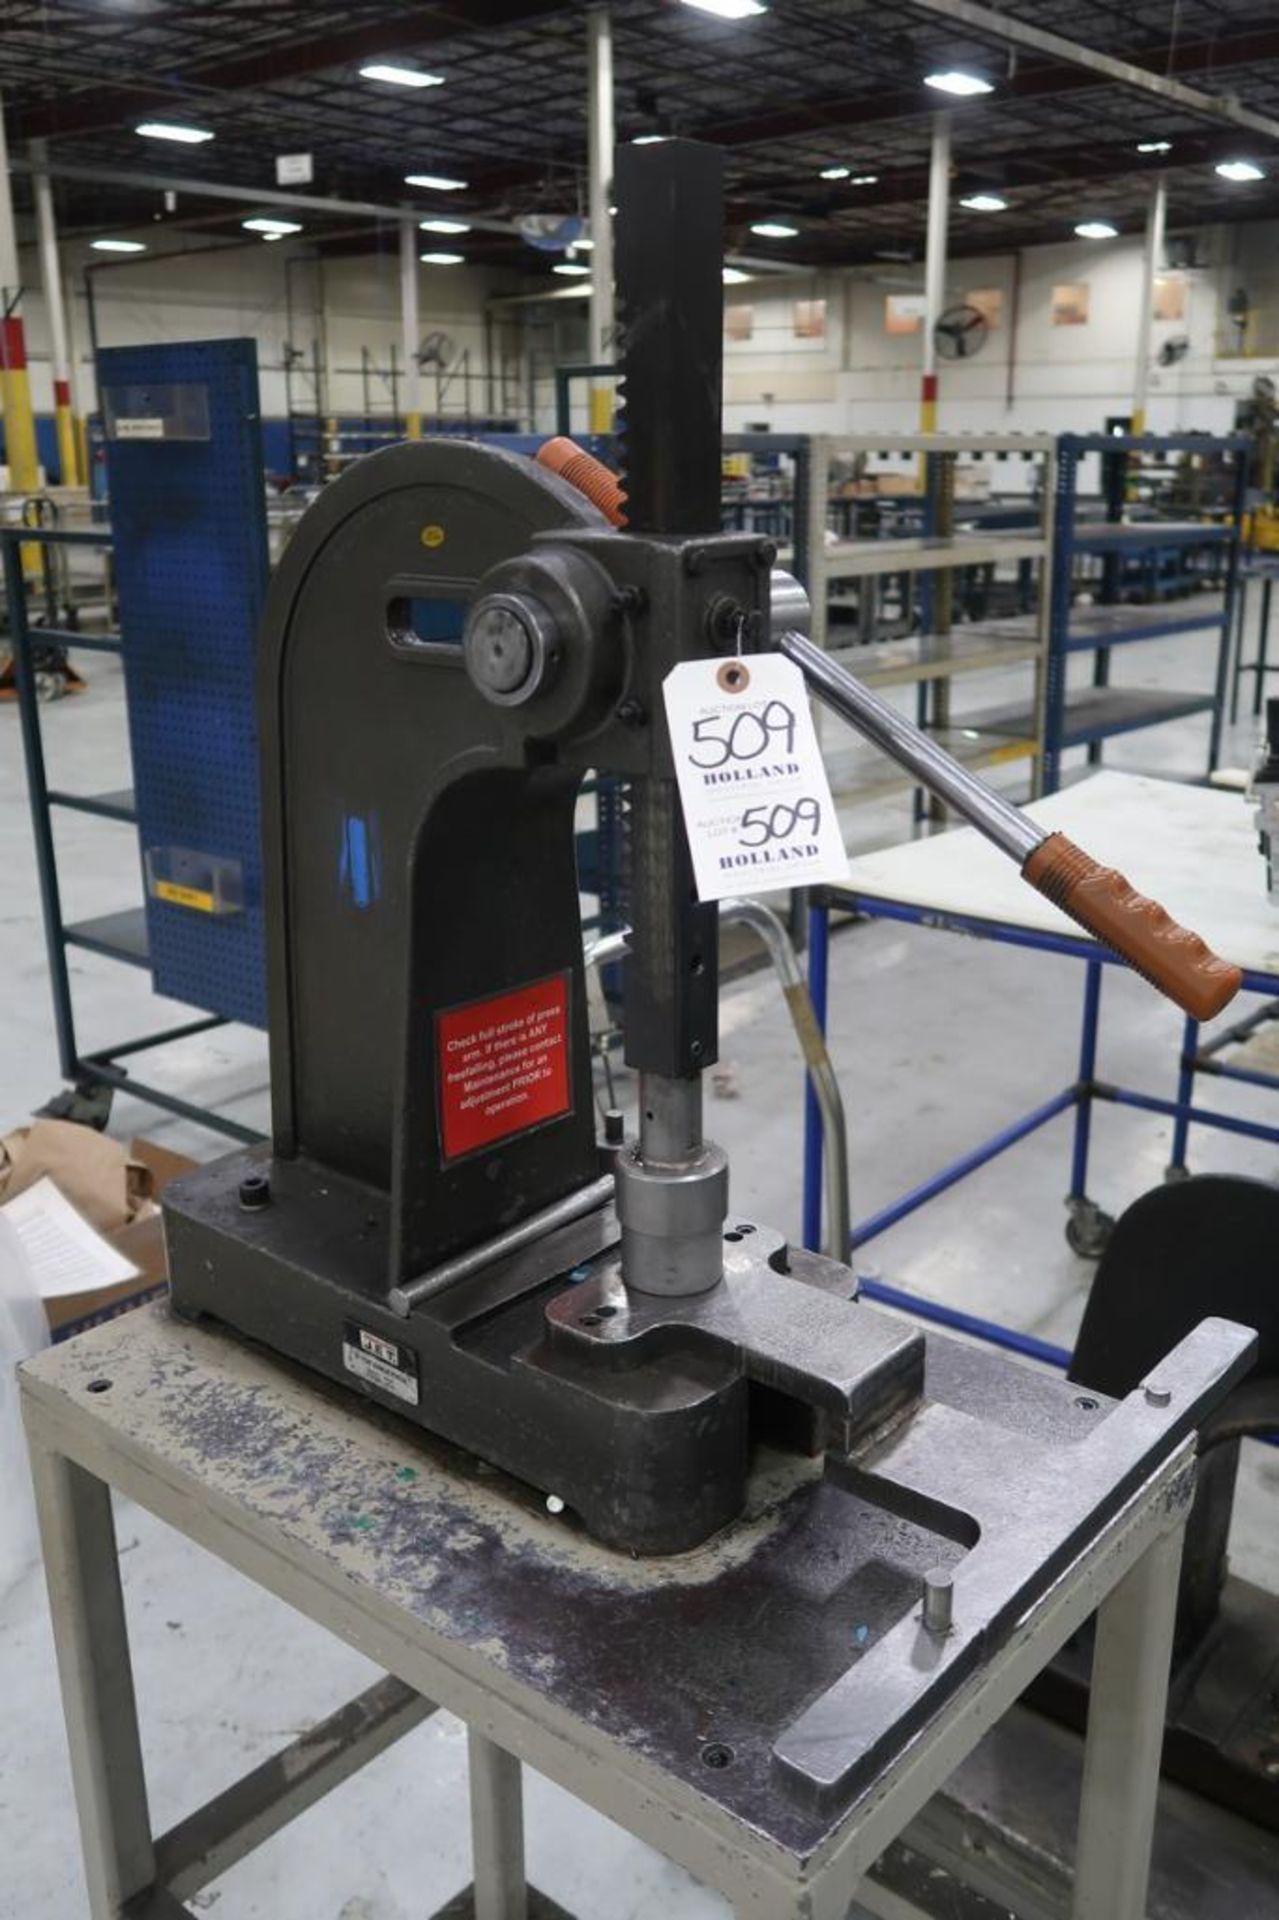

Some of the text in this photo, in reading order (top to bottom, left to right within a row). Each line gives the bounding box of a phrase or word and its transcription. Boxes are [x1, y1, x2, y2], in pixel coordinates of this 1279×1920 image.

[689, 700, 795, 769] 509
[703, 763, 800, 786] HOLLAND
[739, 797, 821, 847] 509
[719, 844, 820, 870] HOLLAND
[447, 1005, 561, 1052] Check full stroke of press
[494, 1036, 518, 1052] there
[528, 1022, 548, 1038] ANY
[498, 1046, 529, 1065] please
[529, 1032, 563, 1054] contact
[460, 1066, 553, 1110] adjustment PRIOR to
[463, 1054, 548, 1093] Maintenance for an
